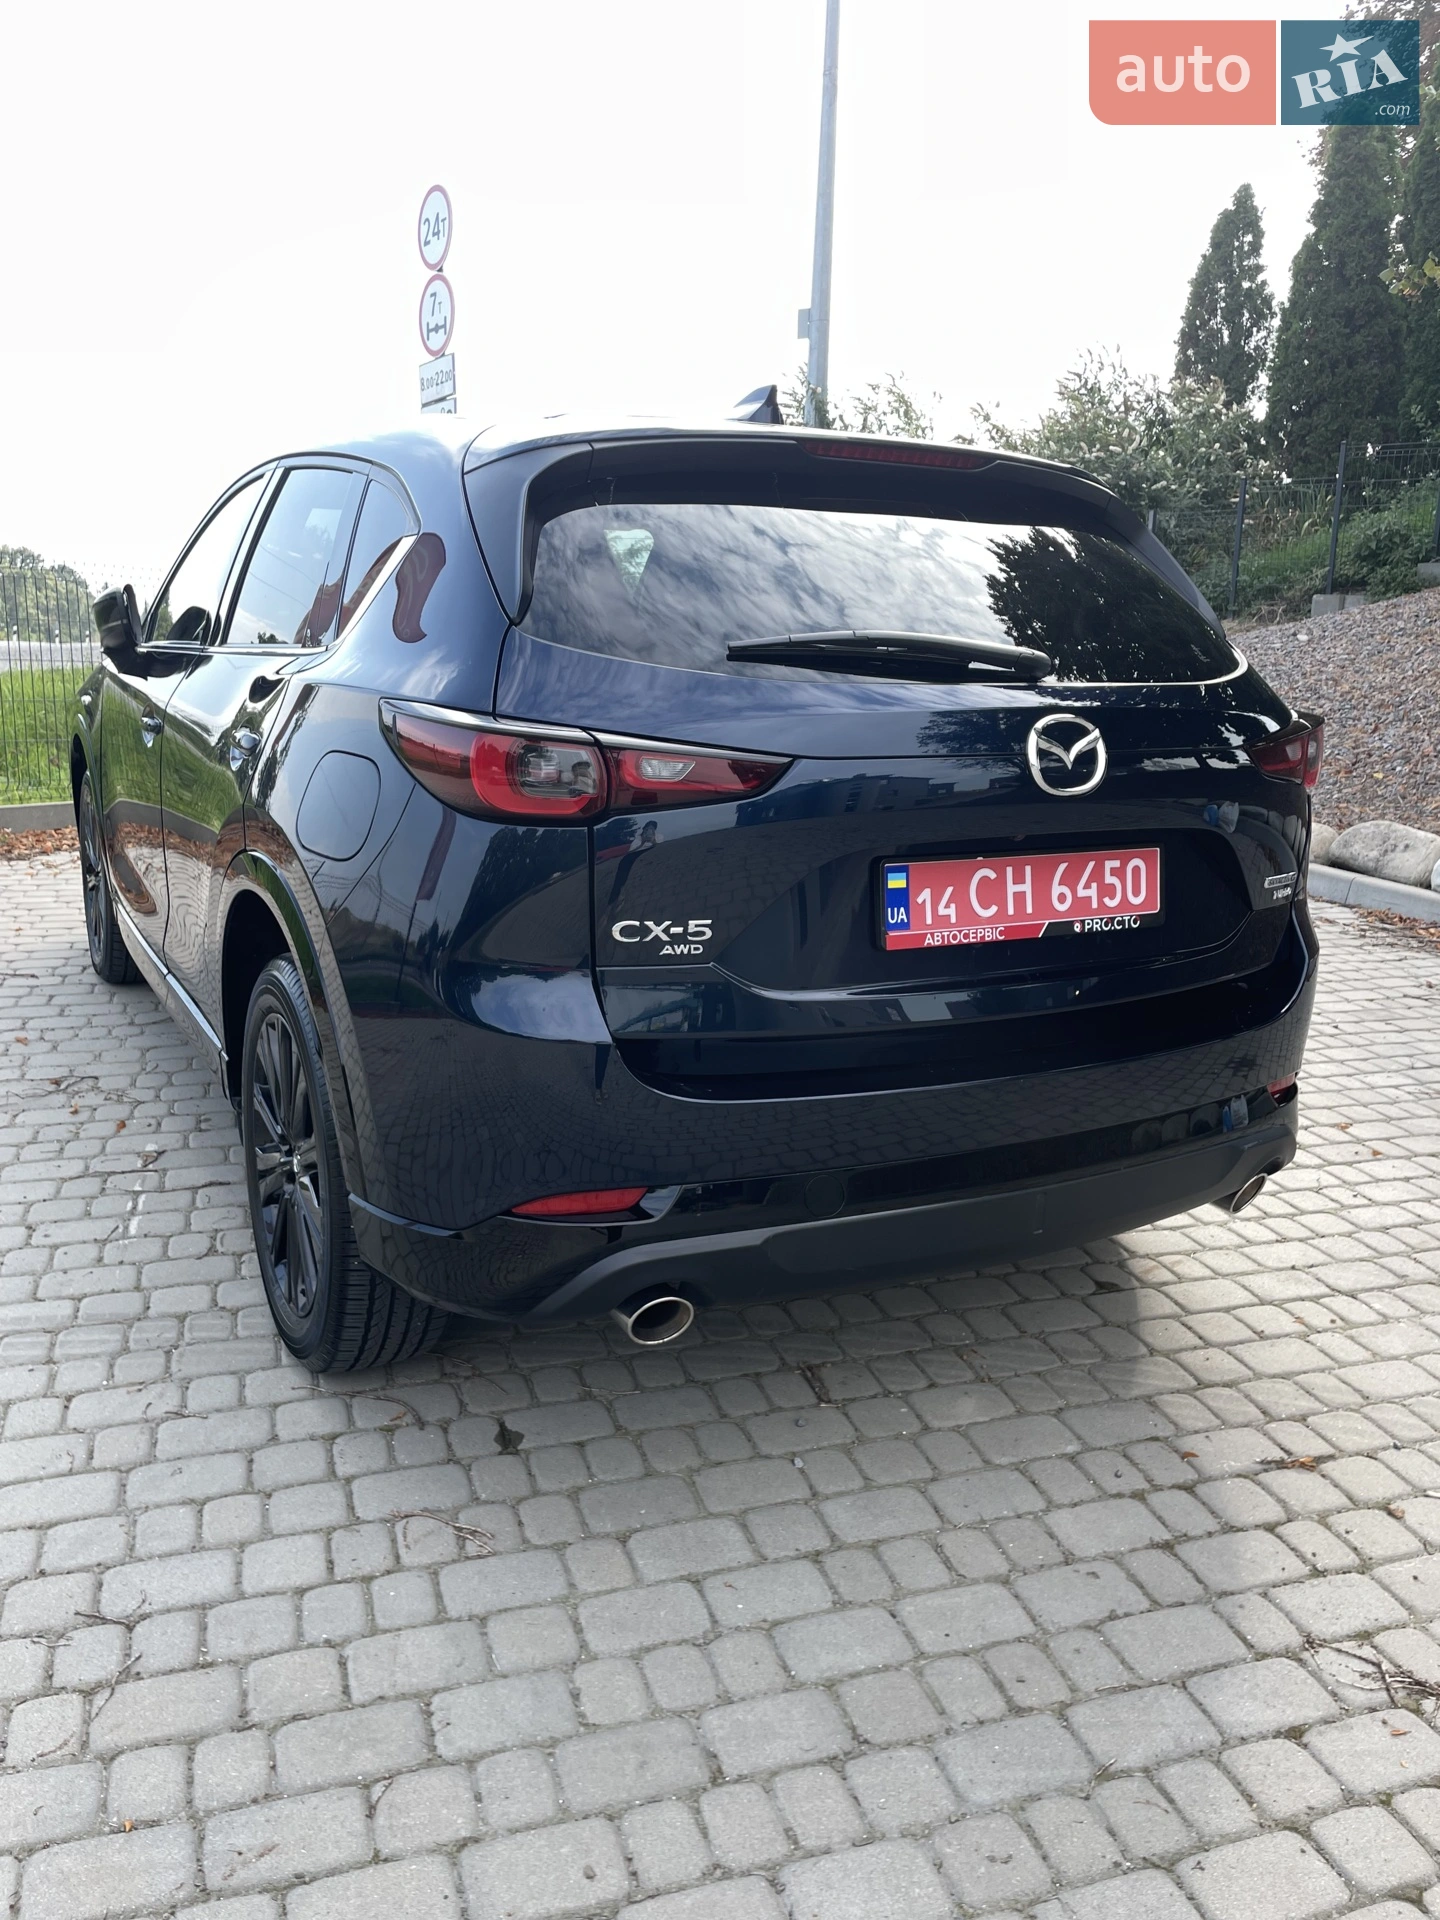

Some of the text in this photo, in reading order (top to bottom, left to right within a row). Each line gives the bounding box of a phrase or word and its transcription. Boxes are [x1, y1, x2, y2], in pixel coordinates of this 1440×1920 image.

[915, 857, 1147, 925] 14 CH 6450
[887, 907, 908, 924] UA
[611, 919, 713, 943] CX-5
[924, 926, 1006, 946] АВТОСЕРВІС
[658, 944, 704, 956] AWD
